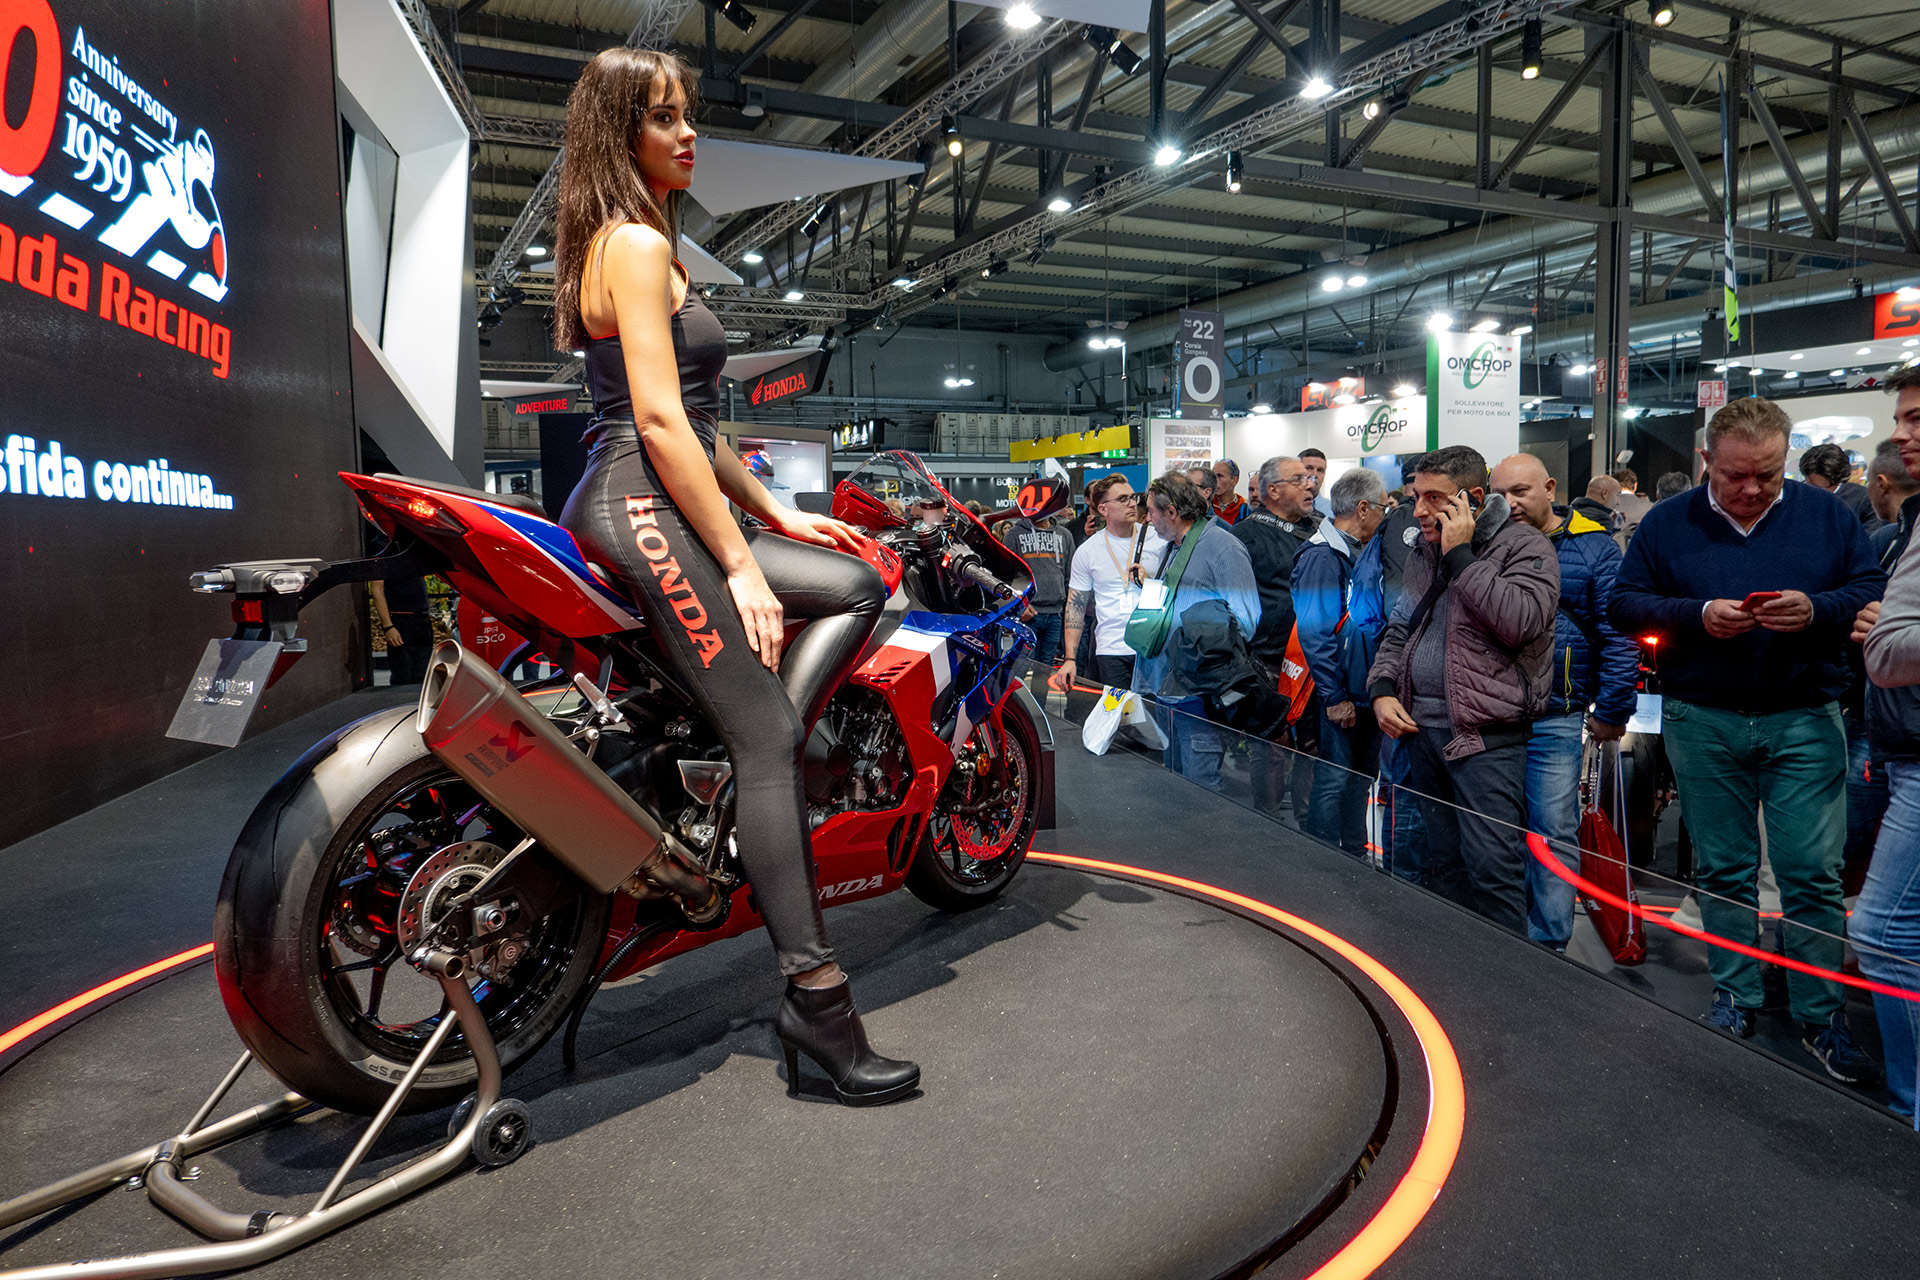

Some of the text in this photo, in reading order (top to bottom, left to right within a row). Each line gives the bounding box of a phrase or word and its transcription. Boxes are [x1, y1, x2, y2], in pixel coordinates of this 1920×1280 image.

[71, 24, 178, 143] Anniversary
[67, 71, 123, 136] since
[62, 111, 134, 203] 1959
[99, 261, 231, 379] Racing
[1192, 319, 1214, 340] 22
[1184, 341, 1202, 349] Corsia
[1184, 348, 1208, 357] Gangway
[1447, 357, 1512, 372] OMCROP
[763, 372, 807, 402] HONDA
[515, 398, 568, 415] ADVENTURE
[1347, 420, 1408, 437] OMCROP
[93, 459, 234, 511] continua...
[996, 478, 1020, 487] BORN
[1007, 485, 1020, 493] TO
[625, 494, 724, 670] HONDA
[818, 874, 884, 901] NDA
[369, 1063, 389, 1077] SP
